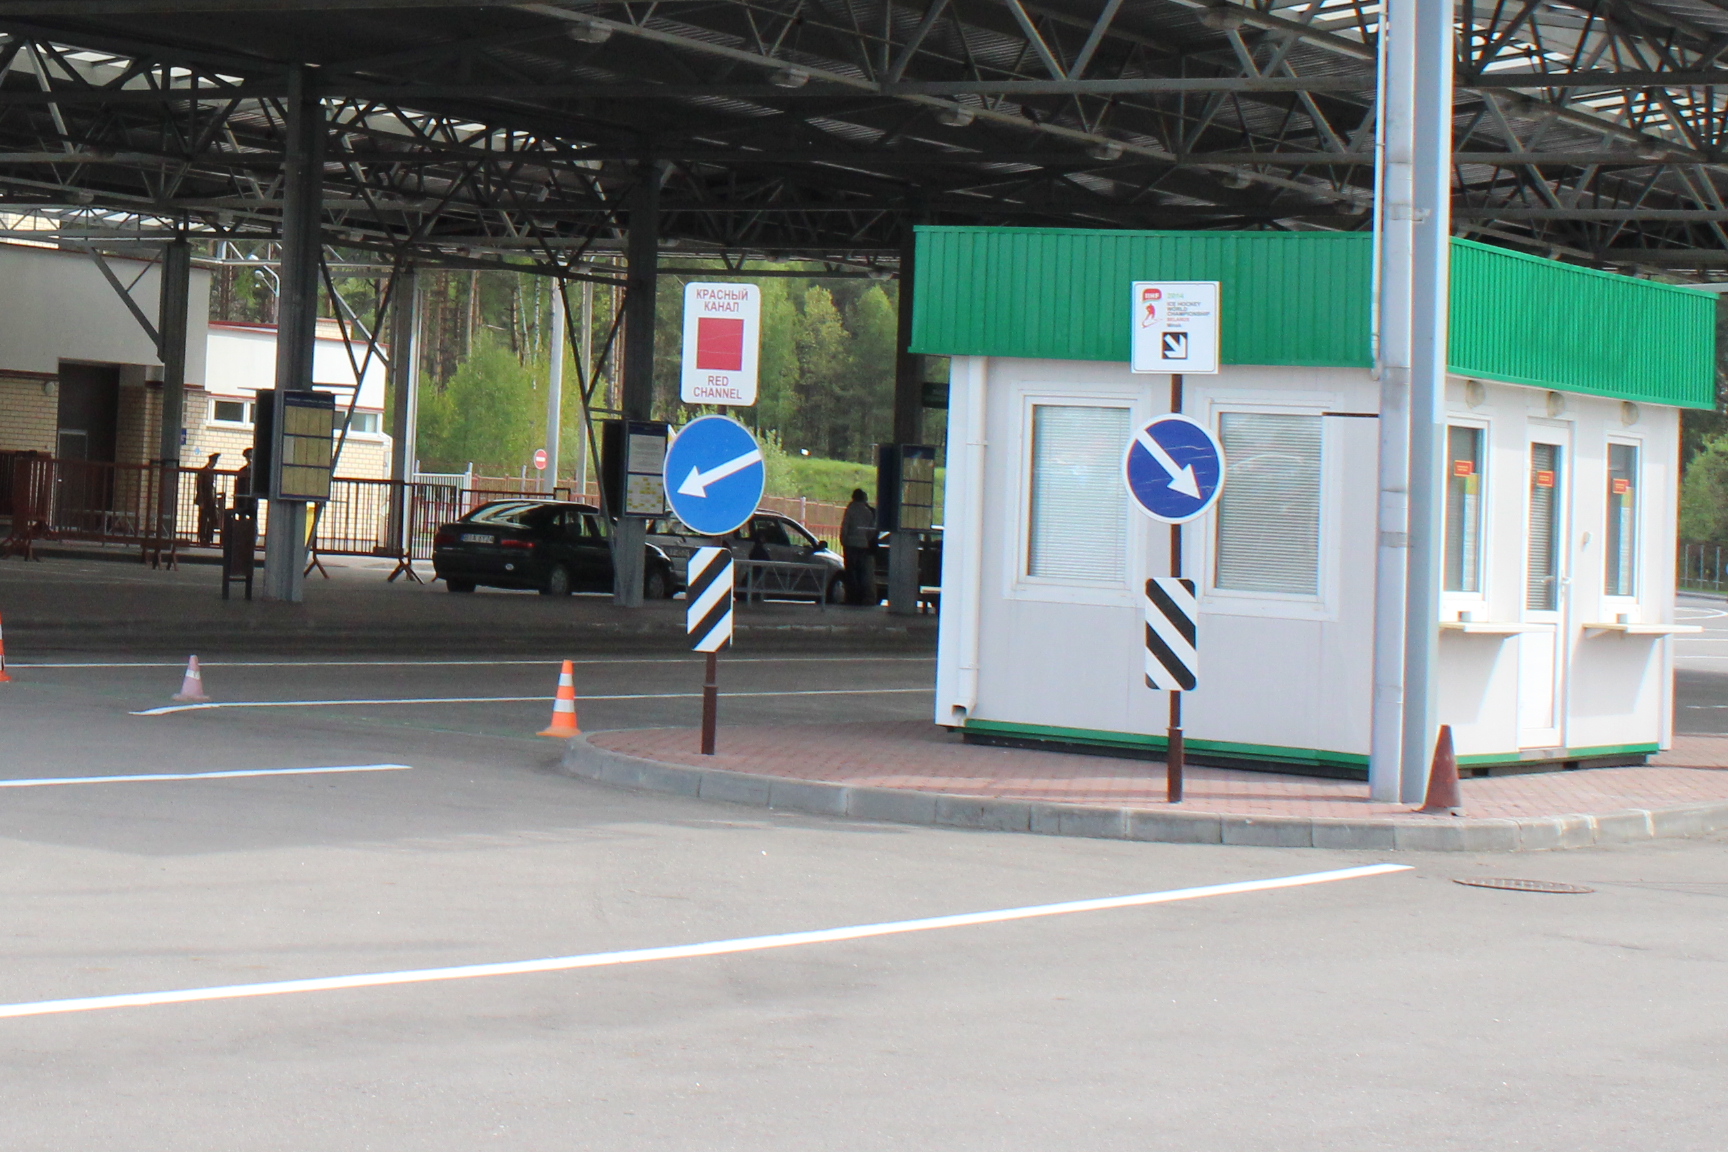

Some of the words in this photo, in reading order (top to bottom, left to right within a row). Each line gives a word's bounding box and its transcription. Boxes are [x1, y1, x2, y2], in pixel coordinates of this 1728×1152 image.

[696, 288, 749, 301] КРАСНЫЙ
[704, 301, 740, 312] КАНАЛ
[707, 375, 729, 387] RED
[693, 386, 743, 399] CHANNEL
